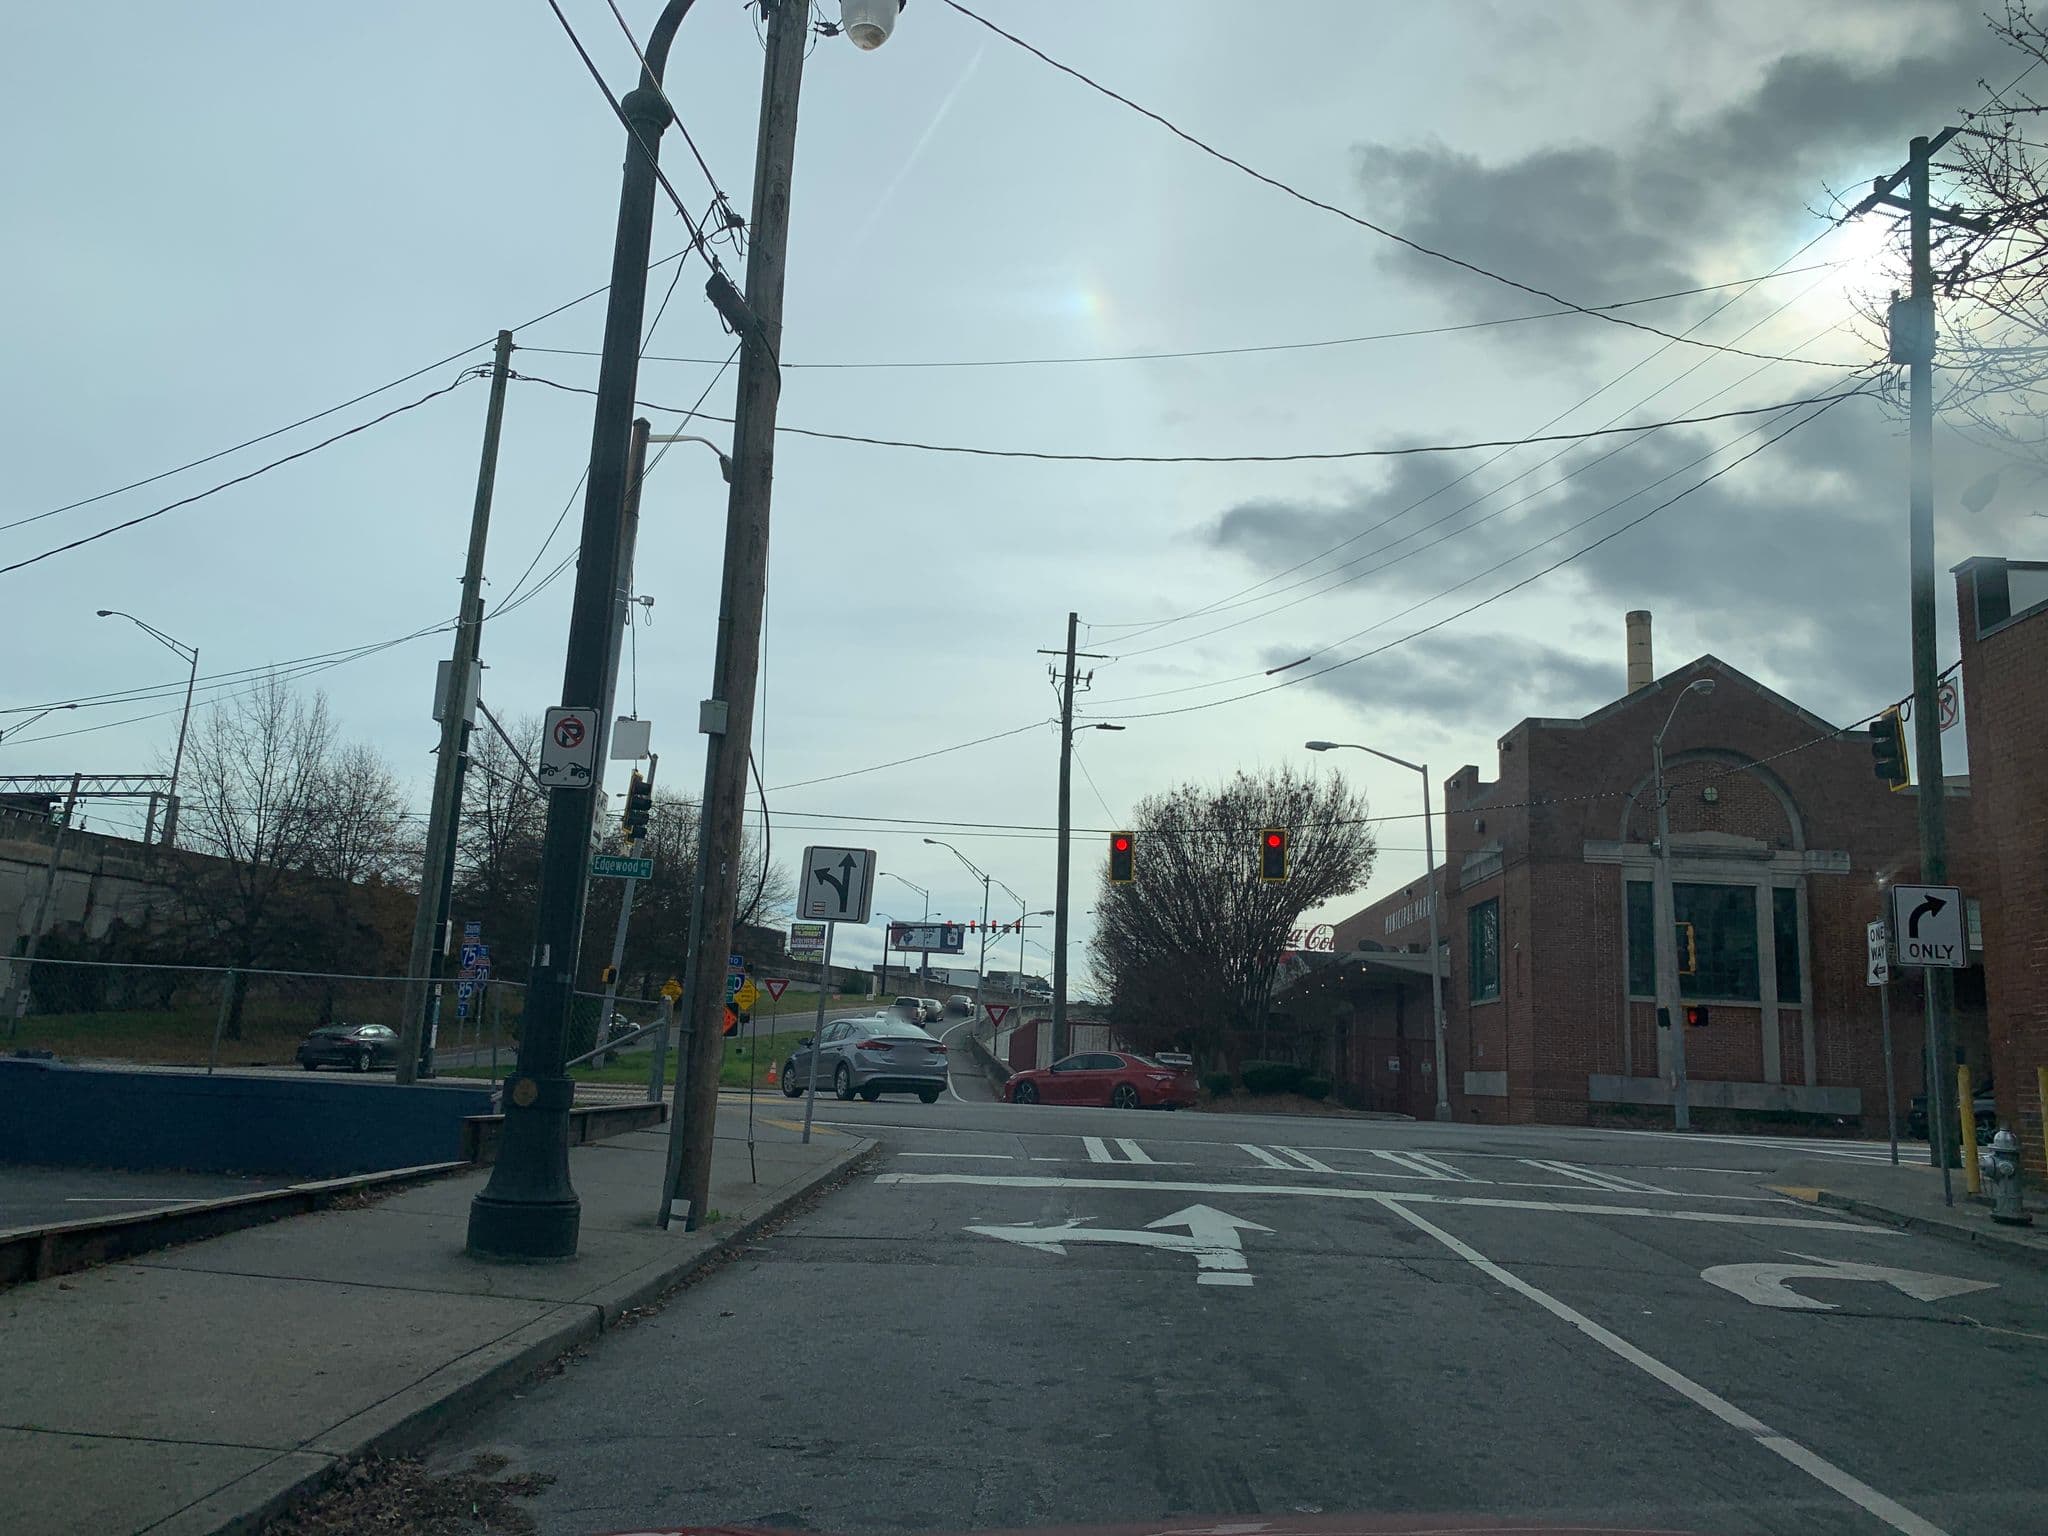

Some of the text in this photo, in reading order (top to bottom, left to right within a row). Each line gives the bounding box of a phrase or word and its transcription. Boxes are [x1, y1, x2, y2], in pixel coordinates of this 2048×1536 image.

[594, 856, 638, 874] Edgewood
[1384, 902, 1413, 936] MUNICIPAL
[1870, 926, 1884, 942] ONE
[463, 947, 477, 966] 75
[1871, 946, 1885, 961] WAY
[1909, 943, 1954, 960] ONLY
[476, 968, 488, 981] 20
[458, 981, 473, 998] 85
